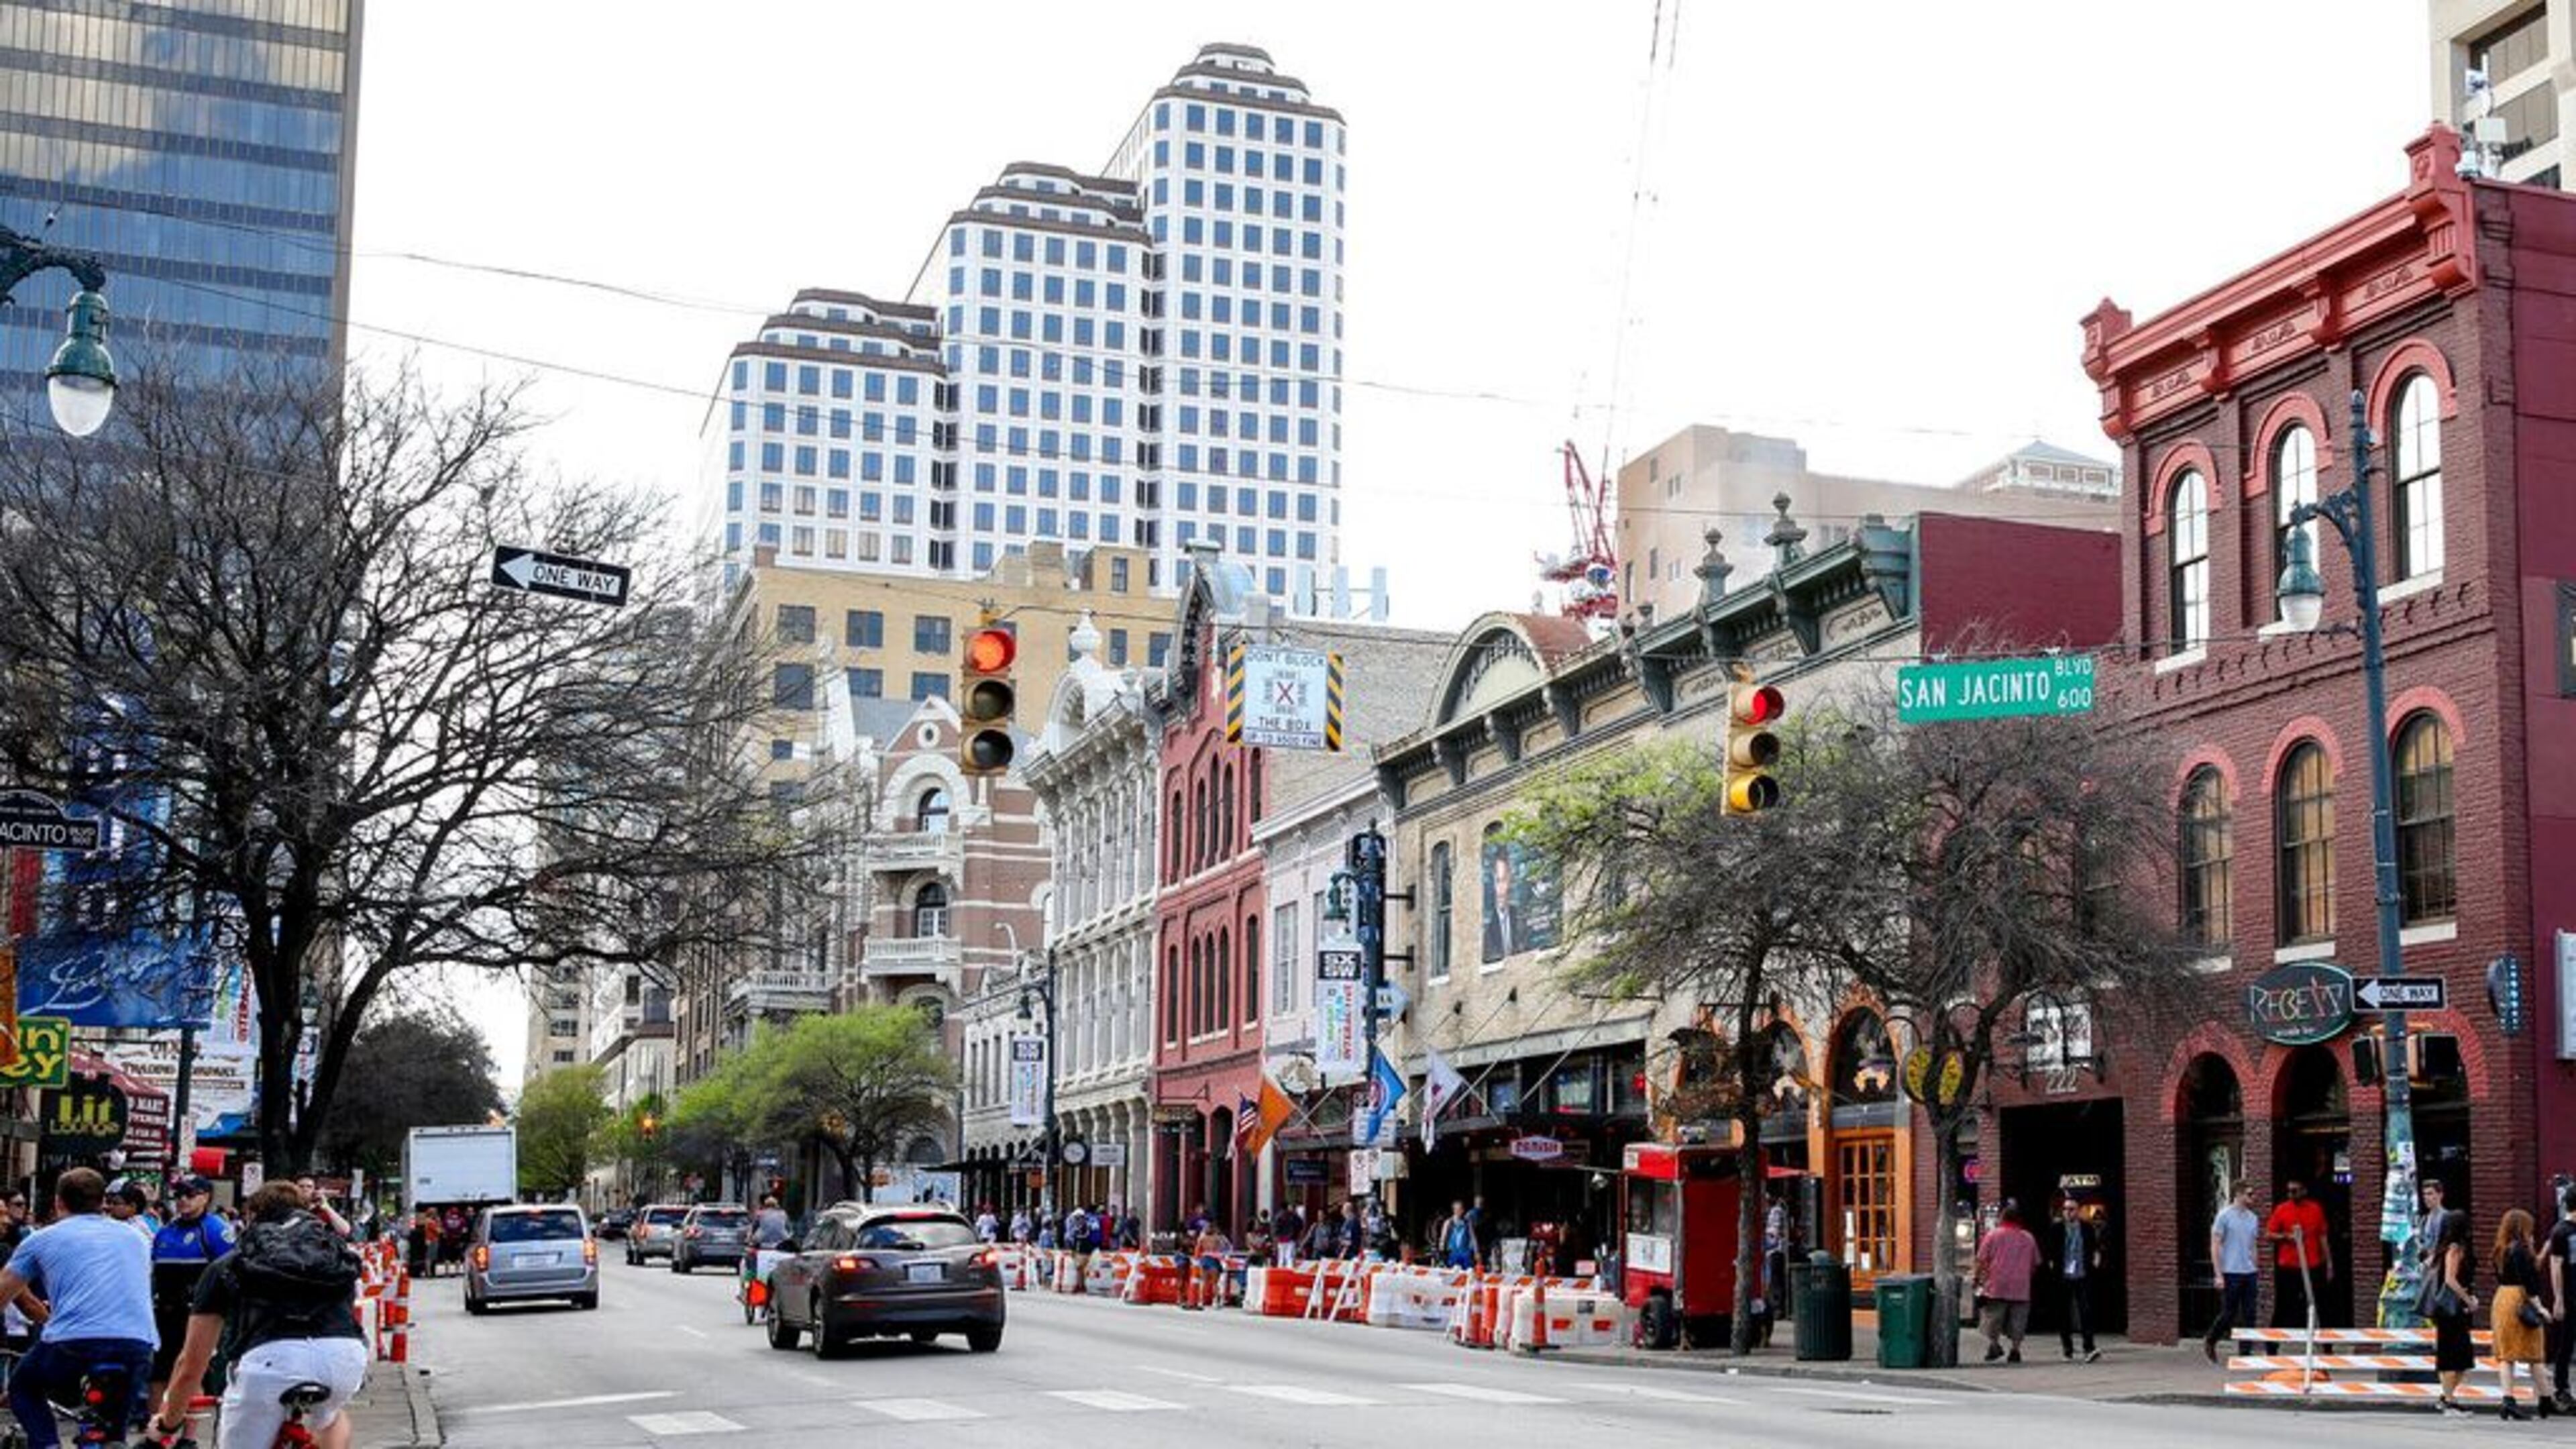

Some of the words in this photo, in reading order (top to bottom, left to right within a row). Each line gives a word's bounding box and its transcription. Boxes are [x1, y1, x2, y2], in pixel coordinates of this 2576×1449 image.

[533, 565, 570, 584] ONE
[577, 573, 614, 592] WAY
[1285, 654, 1324, 667] BLOCK
[2054, 657, 2092, 676] BLVD
[1900, 676, 1946, 708] SAN
[1957, 671, 2051, 706] JACINTO
[2057, 687, 2092, 708] 600
[1259, 716, 1281, 727] THE
[1286, 717, 1311, 731] BOX
[0, 822, 66, 843] ACINTO
[2379, 985, 2405, 1001] ONE
[2409, 985, 2434, 1001] WAY
[192, 1065, 237, 1077] OMPANY
[2045, 1067, 2078, 1094] 222
[59, 1094, 112, 1126] Lit
